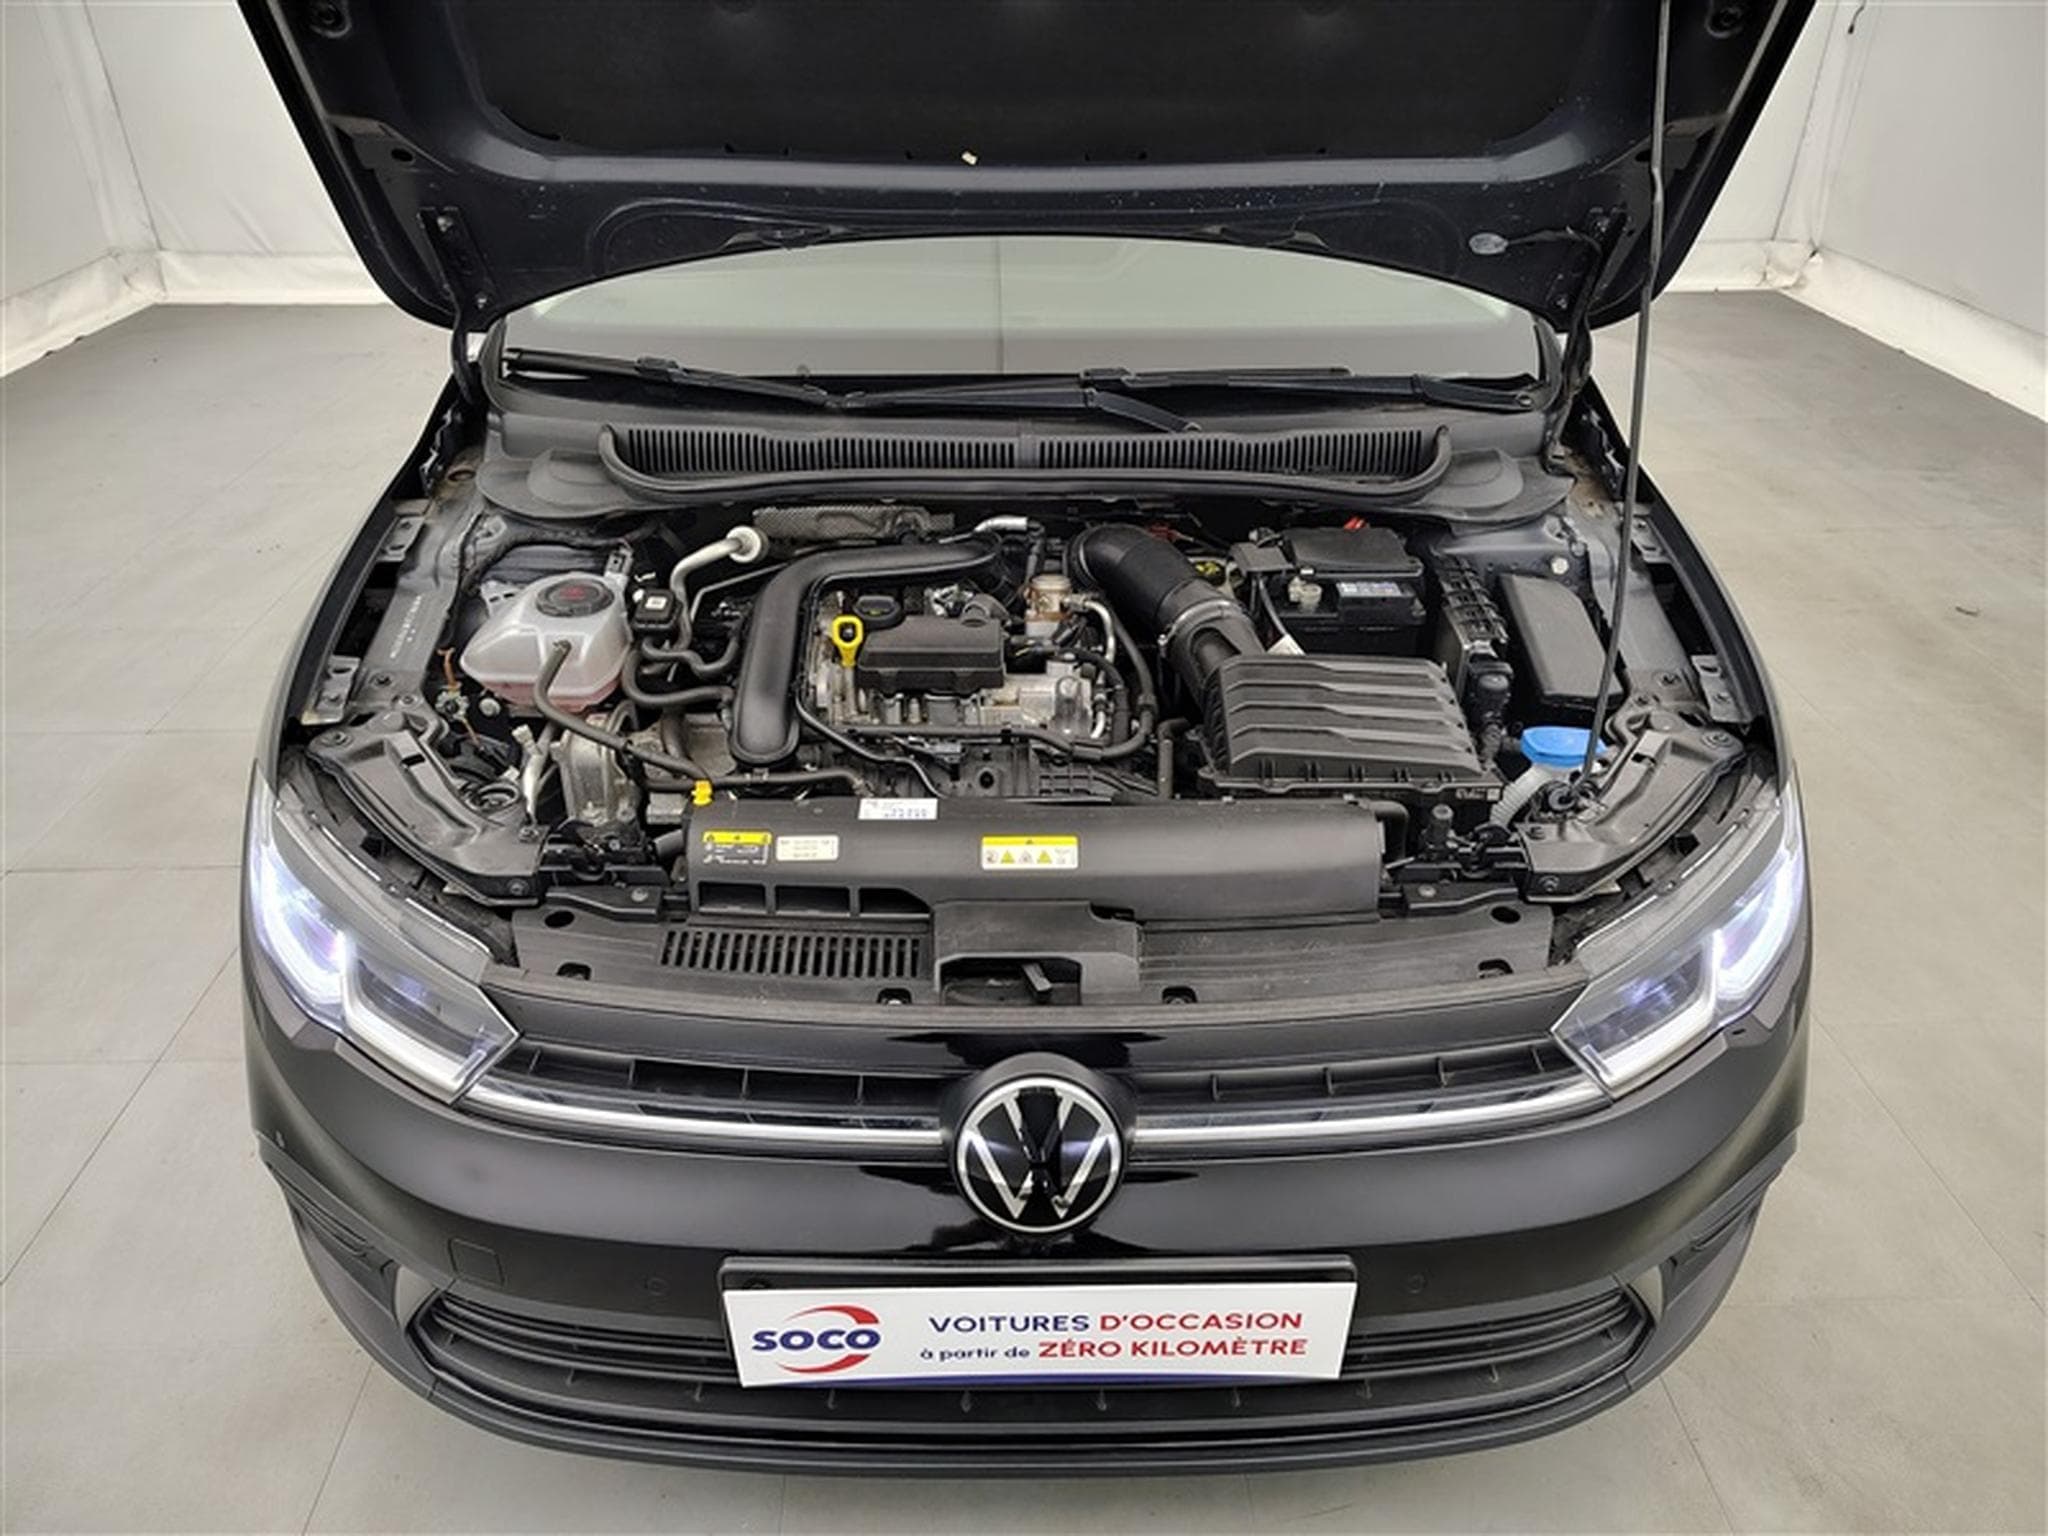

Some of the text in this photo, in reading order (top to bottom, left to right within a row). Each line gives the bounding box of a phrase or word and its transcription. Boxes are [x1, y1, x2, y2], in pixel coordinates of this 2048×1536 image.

[929, 1313, 1302, 1332] VOITURES D'OCCASION
[752, 1329, 881, 1350] SOCO
[920, 1336, 1307, 1361] à partir de ZÉRO KILOMÈTRE
